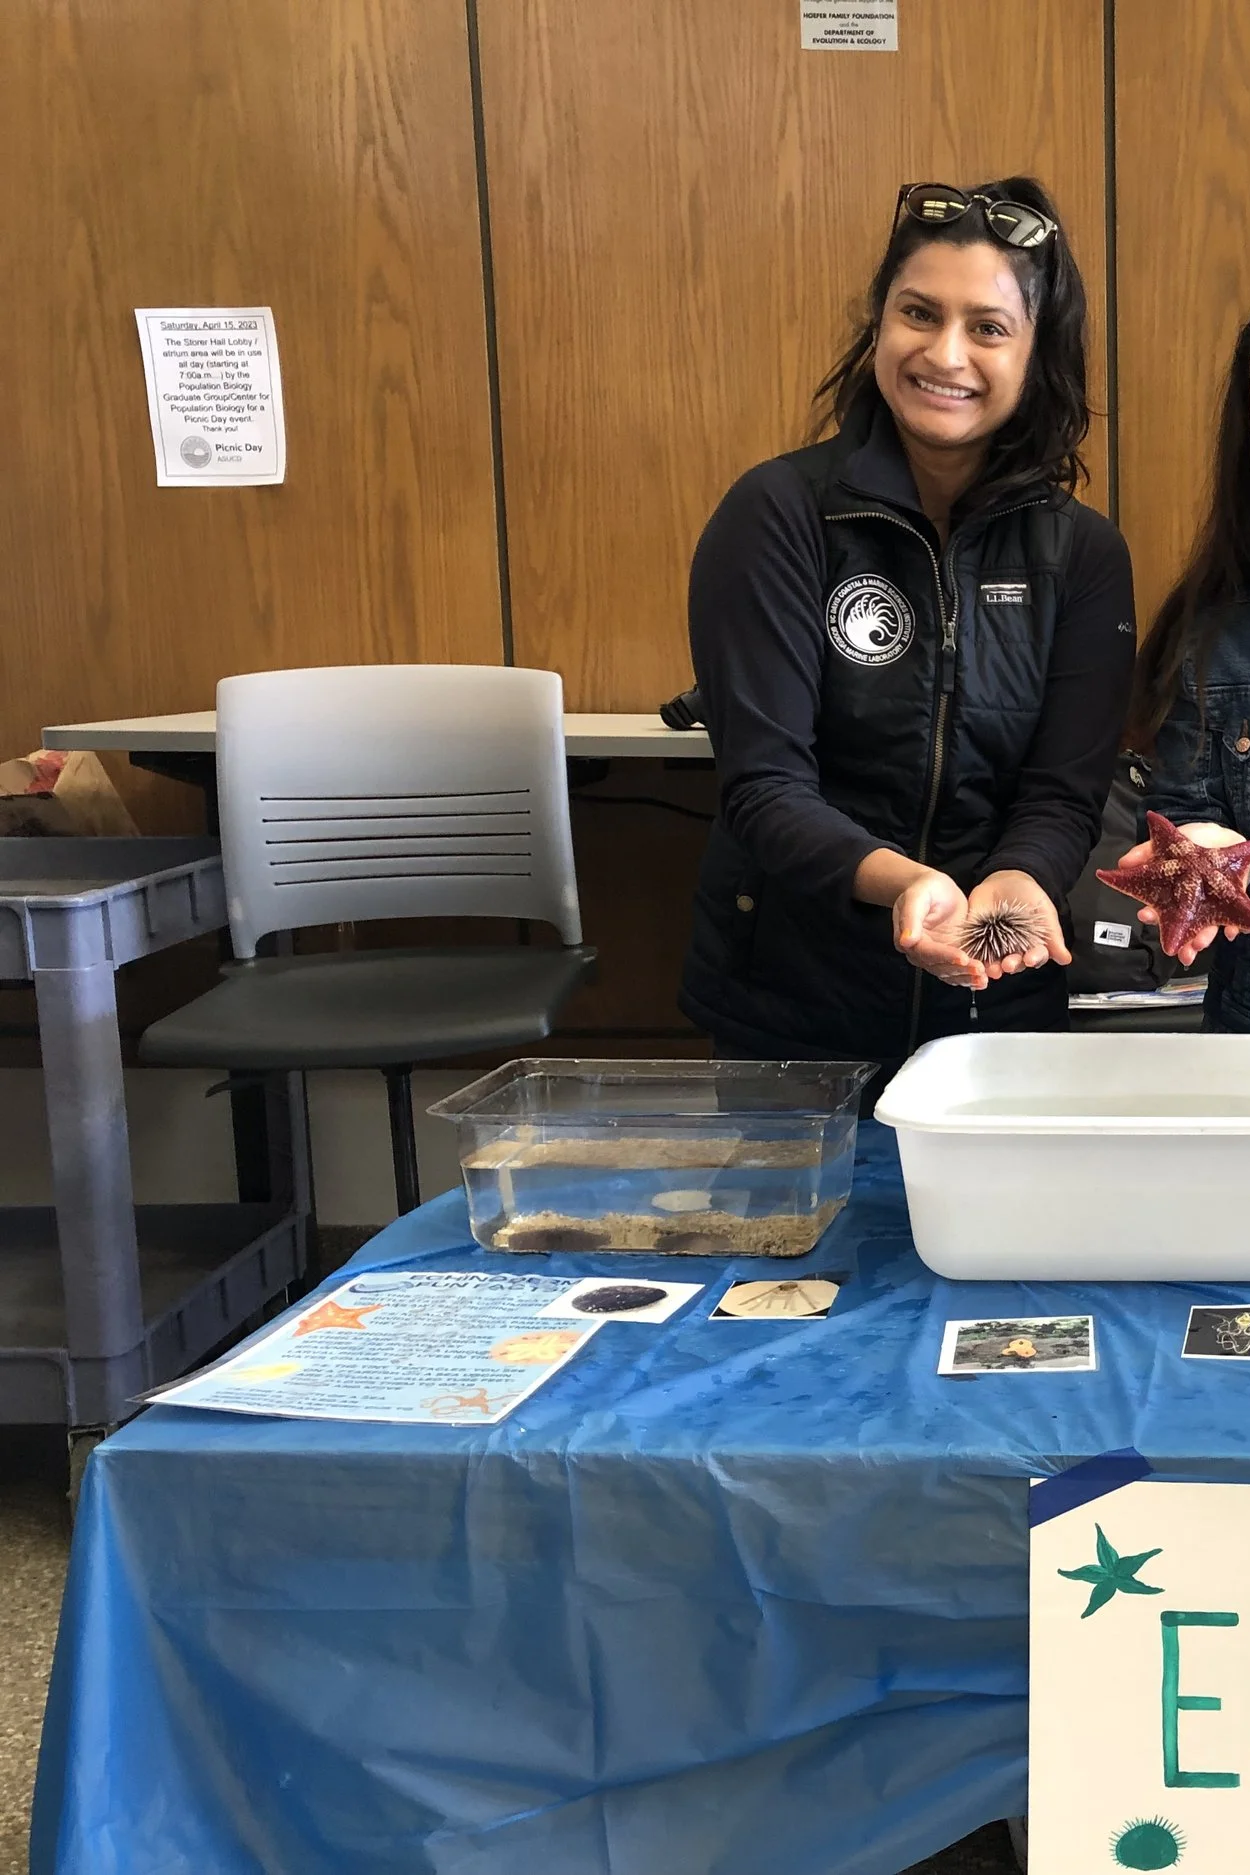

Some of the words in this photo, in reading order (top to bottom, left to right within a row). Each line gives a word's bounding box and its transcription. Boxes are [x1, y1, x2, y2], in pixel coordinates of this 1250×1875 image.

[160, 321, 201, 331] Saturday,
[202, 321, 220, 330] April
[238, 321, 257, 330] 2023
[165, 338, 181, 346] The
[183, 338, 207, 346] Storer
[210, 338, 226, 346] Hall
[228, 338, 253, 347] Lobby
[189, 361, 204, 369] day
[206, 360, 239, 369] (starting
[225, 371, 235, 380] by
[237, 371, 250, 379] the
[178, 382, 221, 391] Population
[223, 382, 252, 391] Biology
[163, 393, 201, 401] Graduate
[203, 393, 257, 402] Group/Center
[259, 392, 270, 400] for
[170, 404, 213, 413] Population
[215, 404, 245, 413] Biology
[247, 403, 258, 411] for
[184, 415, 209, 423] Picnic
[210, 415, 227, 424] Day
[215, 443, 243, 452] Picnic
[245, 443, 263, 453] Day
[838, 580, 862, 598] COASTAL
[868, 578, 888, 591] MARINE
[830, 597, 841, 614] DAVIS
[830, 615, 836, 624] UC
[901, 613, 912, 642] INSTITUTE
[831, 626, 847, 650] BODEGA
[845, 646, 868, 662] MARINE
[868, 643, 904, 663] LABORATORY
